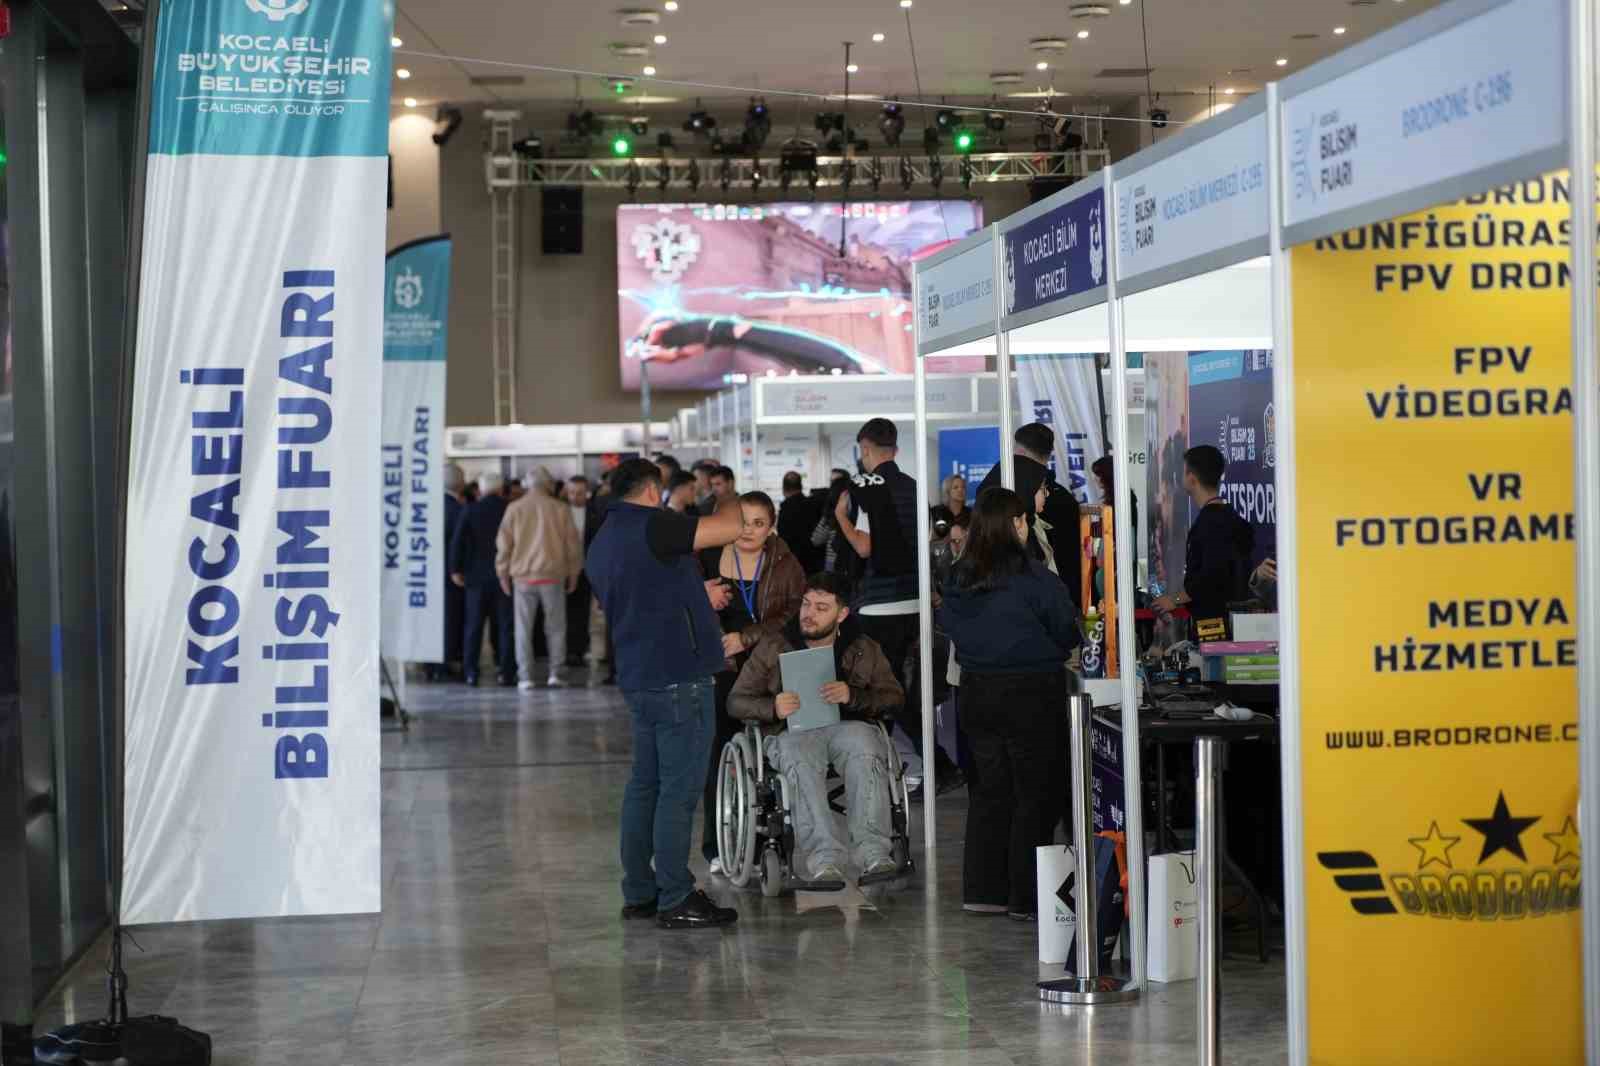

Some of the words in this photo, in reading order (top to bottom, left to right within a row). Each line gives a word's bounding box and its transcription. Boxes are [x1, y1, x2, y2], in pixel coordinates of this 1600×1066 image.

[177, 53, 370, 76] BÜYÜKŞEHİR
[199, 75, 345, 95] BELEDİYESİ
[1320, 161, 1353, 193] FUARI
[1023, 224, 1055, 265] KOCAELİ
[1034, 260, 1068, 301] MERKEZİ
[1375, 263, 1453, 292] FPV
[1454, 345, 1532, 375] FPV
[277, 269, 335, 489] FUARI
[1366, 384, 1574, 419] VİDEOGRA
[411, 407, 430, 494] FUARI
[1468, 473, 1522, 501] VR
[381, 444, 402, 570] KOCAELİ
[180, 367, 244, 686] KOCAELİ
[1428, 598, 1569, 628] MEDYA
[262, 509, 341, 780] BİLİŞİM
[1374, 637, 1577, 673] HİZMETLE
